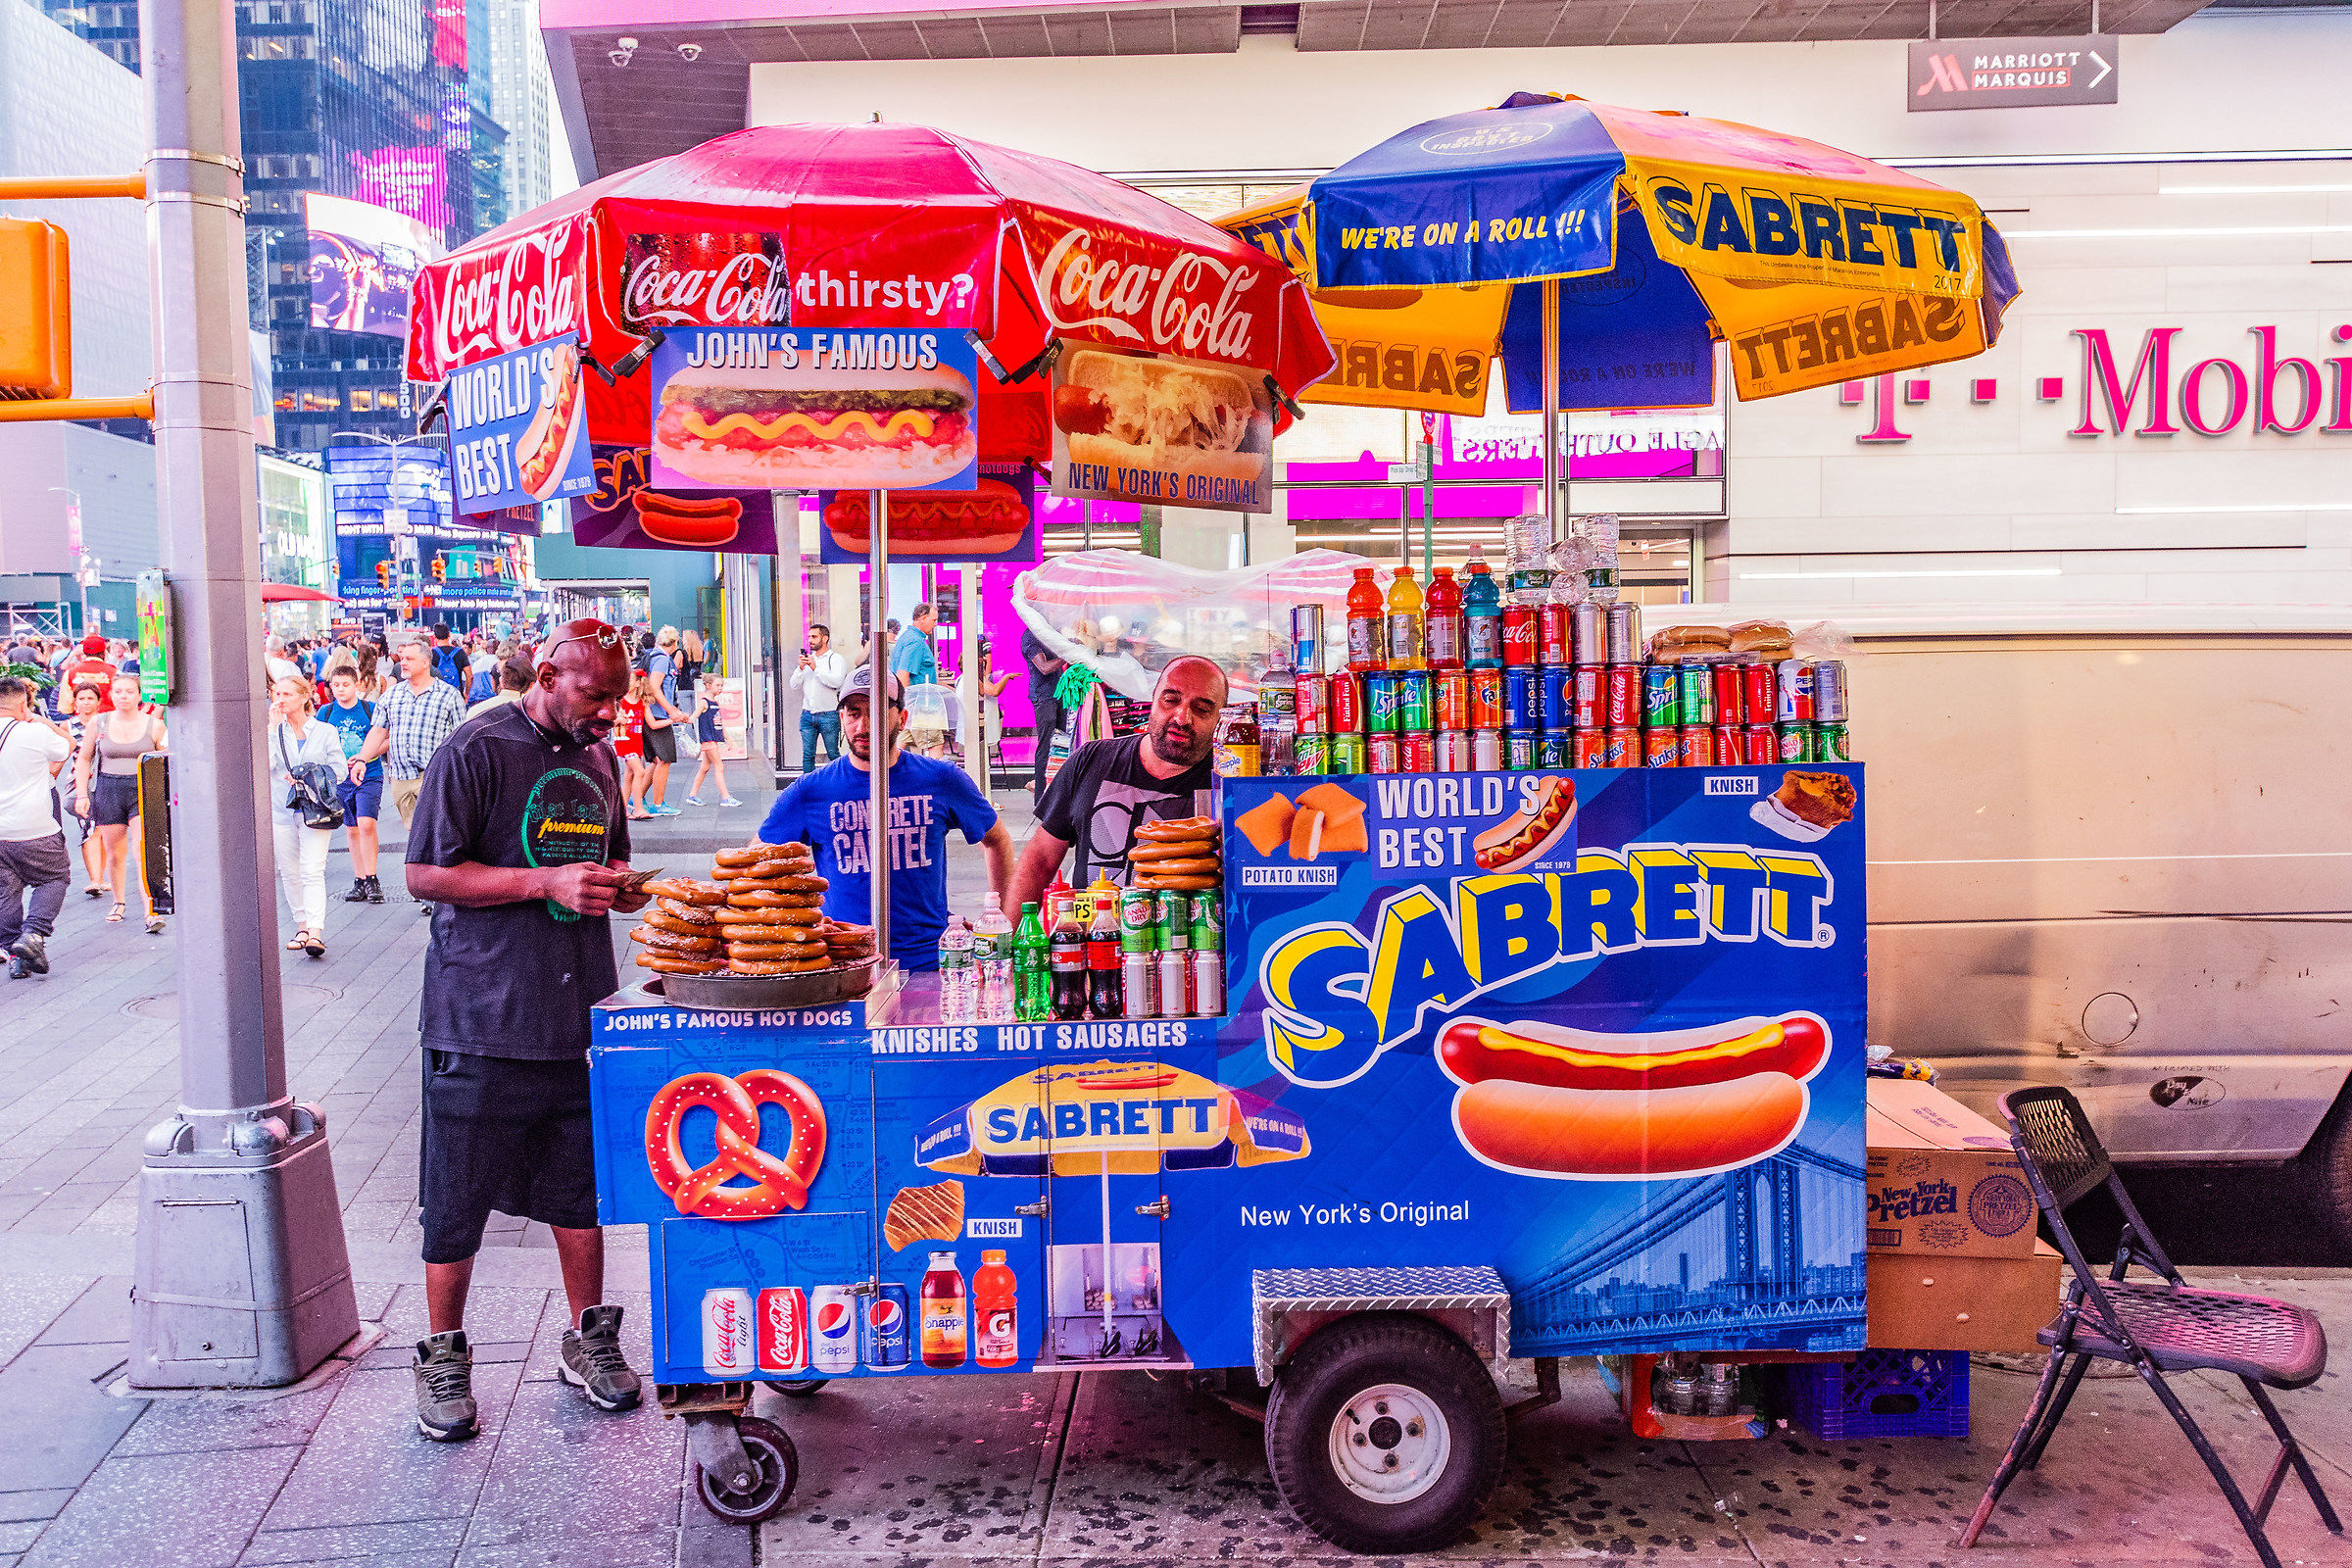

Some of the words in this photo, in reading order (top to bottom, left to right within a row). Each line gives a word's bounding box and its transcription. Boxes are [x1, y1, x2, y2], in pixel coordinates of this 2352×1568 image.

[1973, 52, 2082, 70] MARRIOTT
[1973, 70, 2068, 88] MARQUIS
[1341, 224, 1417, 251] WE'RE
[1423, 221, 1458, 247] ON
[1464, 220, 1480, 243] A
[1489, 216, 1548, 243] ROLL
[1647, 176, 1966, 273] SABRETT
[440, 221, 576, 362] Coca-Cola
[623, 251, 790, 324] Coca-Cola
[800, 271, 975, 315] thirsty?
[1037, 227, 1259, 361] Coca-Cola
[1934, 274, 1962, 291] 2017
[686, 331, 801, 370] JOHN'S
[811, 331, 939, 370] FAMOUS
[451, 347, 557, 429] WORLD'S
[455, 433, 514, 500] BEST
[1068, 462, 1114, 491] NEW
[1120, 465, 1180, 496] YORK'S
[1186, 470, 1259, 506] ORIGINAL
[1609, 673, 1627, 724] Coca-Cola
[1376, 775, 1542, 820] WORLD'S
[1709, 777, 1755, 794] KNISH
[537, 817, 606, 839] premium
[829, 795, 934, 833] CONRETE
[832, 825, 933, 874] CATEL
[1377, 825, 1468, 869] BEST
[1534, 860, 1553, 870] SINCE
[1554, 860, 1572, 870] 1979
[1244, 868, 1293, 885] POTATO
[1297, 867, 1336, 884] KNISH
[1260, 844, 1834, 1088] SABRETT
[605, 1012, 671, 1032] JOHN'S
[676, 1012, 755, 1029] FAMOUS
[760, 1010, 798, 1028] HOT
[803, 1010, 853, 1027] DOGS
[871, 1026, 979, 1054] KNISHES
[998, 1025, 1047, 1053] HOT
[1056, 1023, 1189, 1051] SAUSAGES
[984, 1096, 1219, 1145] SABRETT
[1246, 1115, 1268, 1132] WE'RE
[1882, 1186, 1912, 1203] New
[1916, 1177, 1951, 1198] York
[973, 1220, 1018, 1236] KNISH
[1241, 1204, 1292, 1227] New
[1298, 1201, 1372, 1226] York's
[1379, 1199, 1470, 1229] Original
[712, 1295, 737, 1369] Coca-Cola
[769, 1295, 793, 1366] Coca-Cola
[925, 1314, 965, 1331] Snapple
[989, 1311, 1011, 1338] G
[819, 1345, 851, 1357] pepsi
[870, 1335, 904, 1349] pepsi
